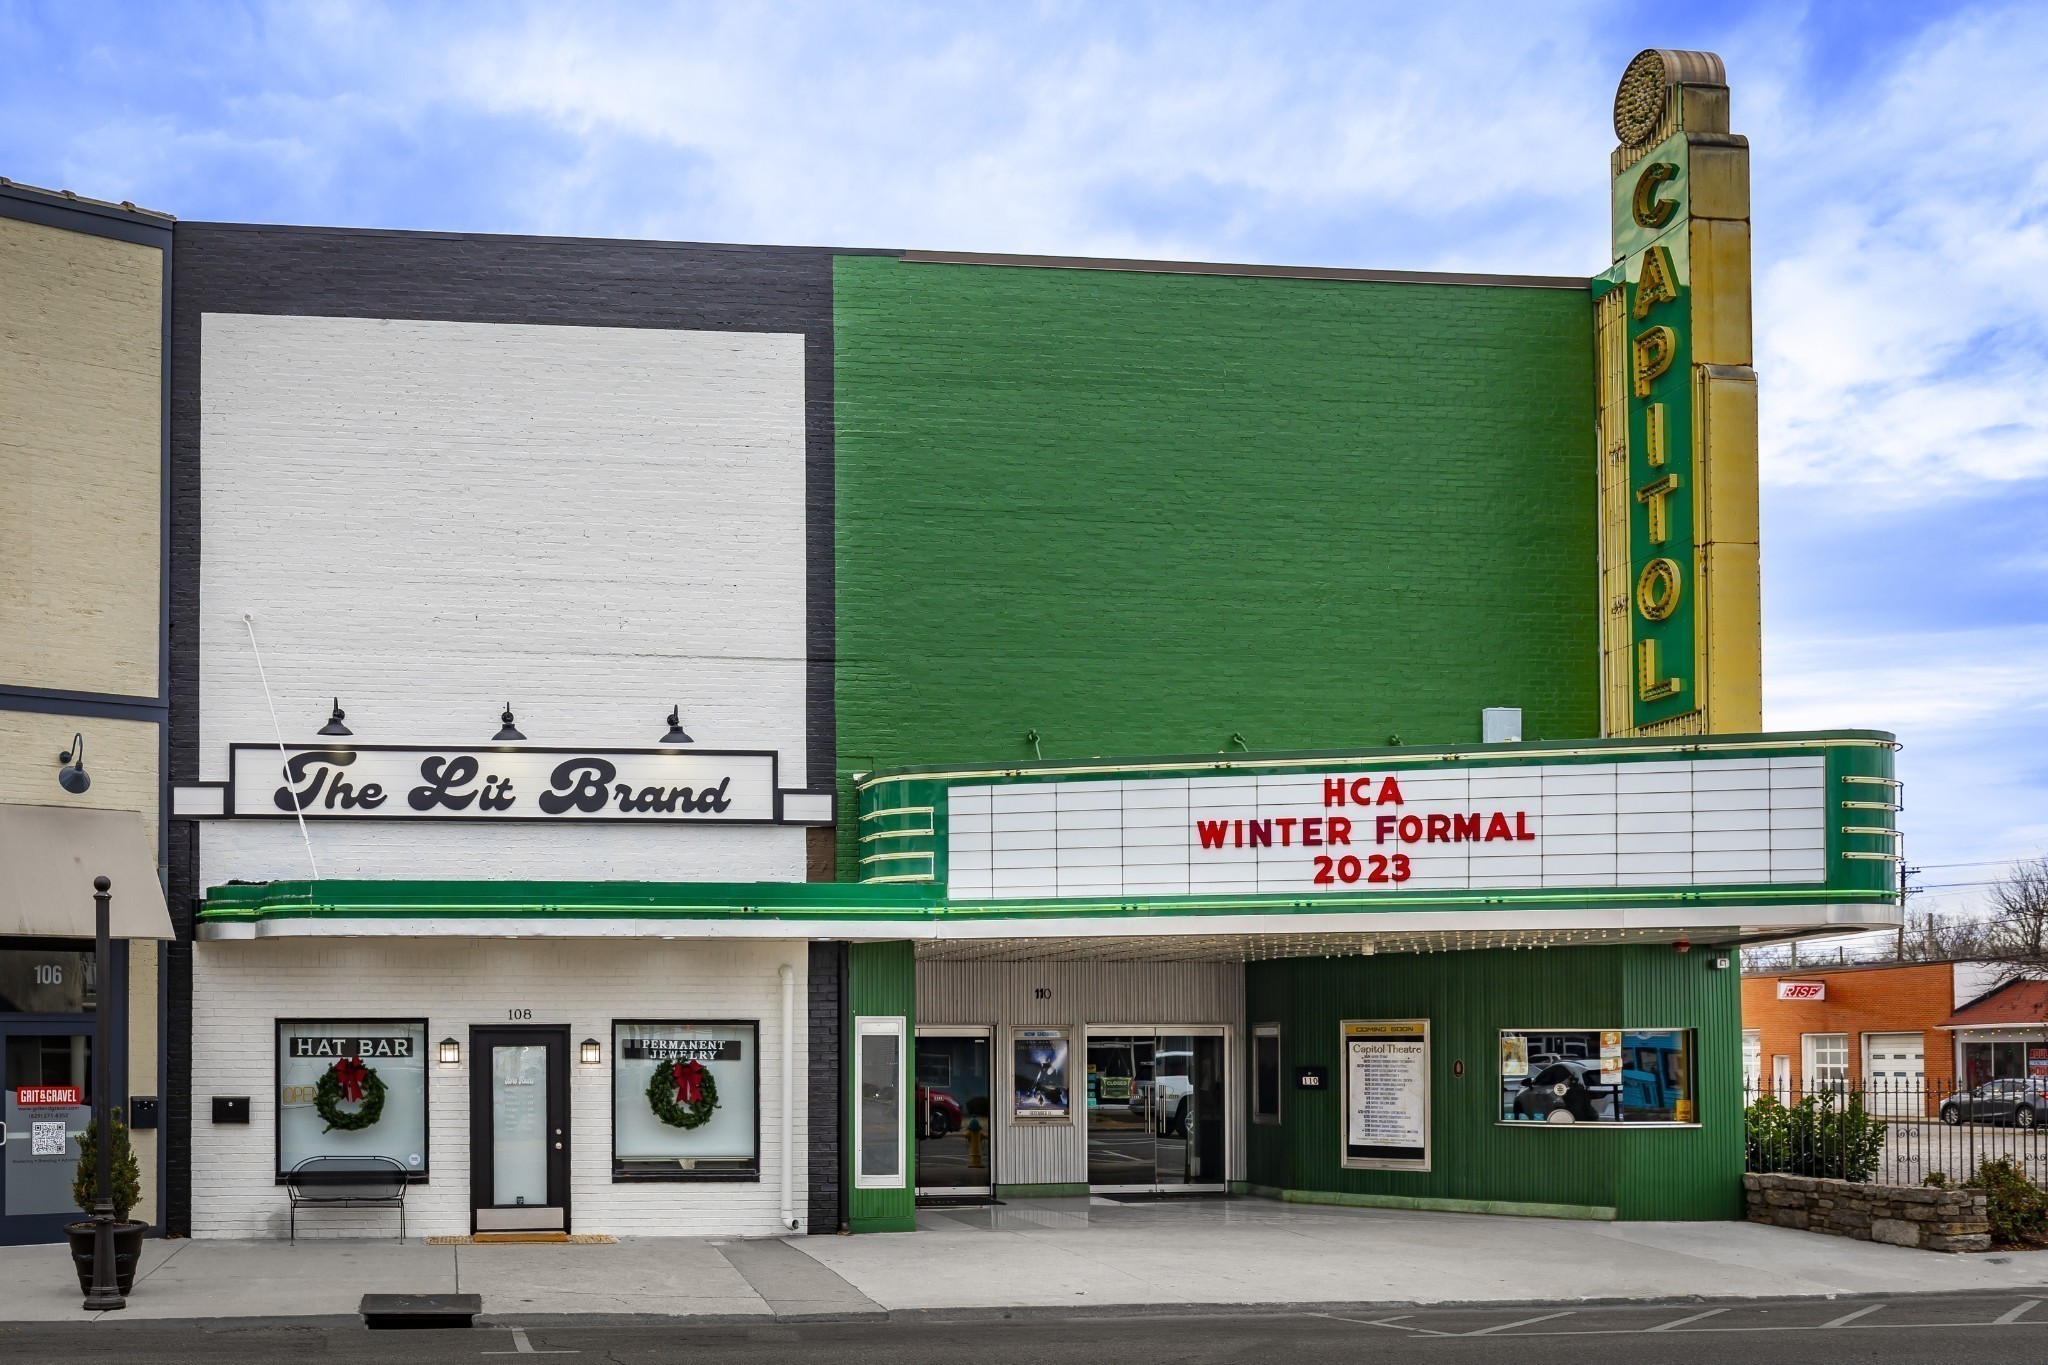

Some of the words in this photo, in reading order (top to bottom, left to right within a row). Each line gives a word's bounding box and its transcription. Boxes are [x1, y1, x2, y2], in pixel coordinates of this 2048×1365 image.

[1632, 162, 1682, 702] CAPITOL
[273, 751, 389, 813] The
[408, 755, 517, 813] Lit
[538, 756, 732, 815] Brand
[1323, 776, 1405, 807] HCA
[1197, 816, 1352, 849] WINTER
[1376, 811, 1536, 845] FORMAL
[1313, 854, 1412, 884] 2023
[34, 964, 63, 985] 106
[1034, 987, 1052, 1000] 110
[1783, 985, 1821, 998] RISE
[508, 1008, 532, 1021] 108
[296, 1038, 346, 1056] HAT
[358, 1039, 409, 1057] BAR
[642, 1039, 726, 1050] PERMANENT
[1353, 1043, 1385, 1055] Capitol
[1386, 1044, 1422, 1054] Theatre
[650, 1049, 718, 1060] JEWELRY
[1303, 1077, 1319, 1085] 110
[20, 1089, 77, 1103] GRIT&GRAVEL
